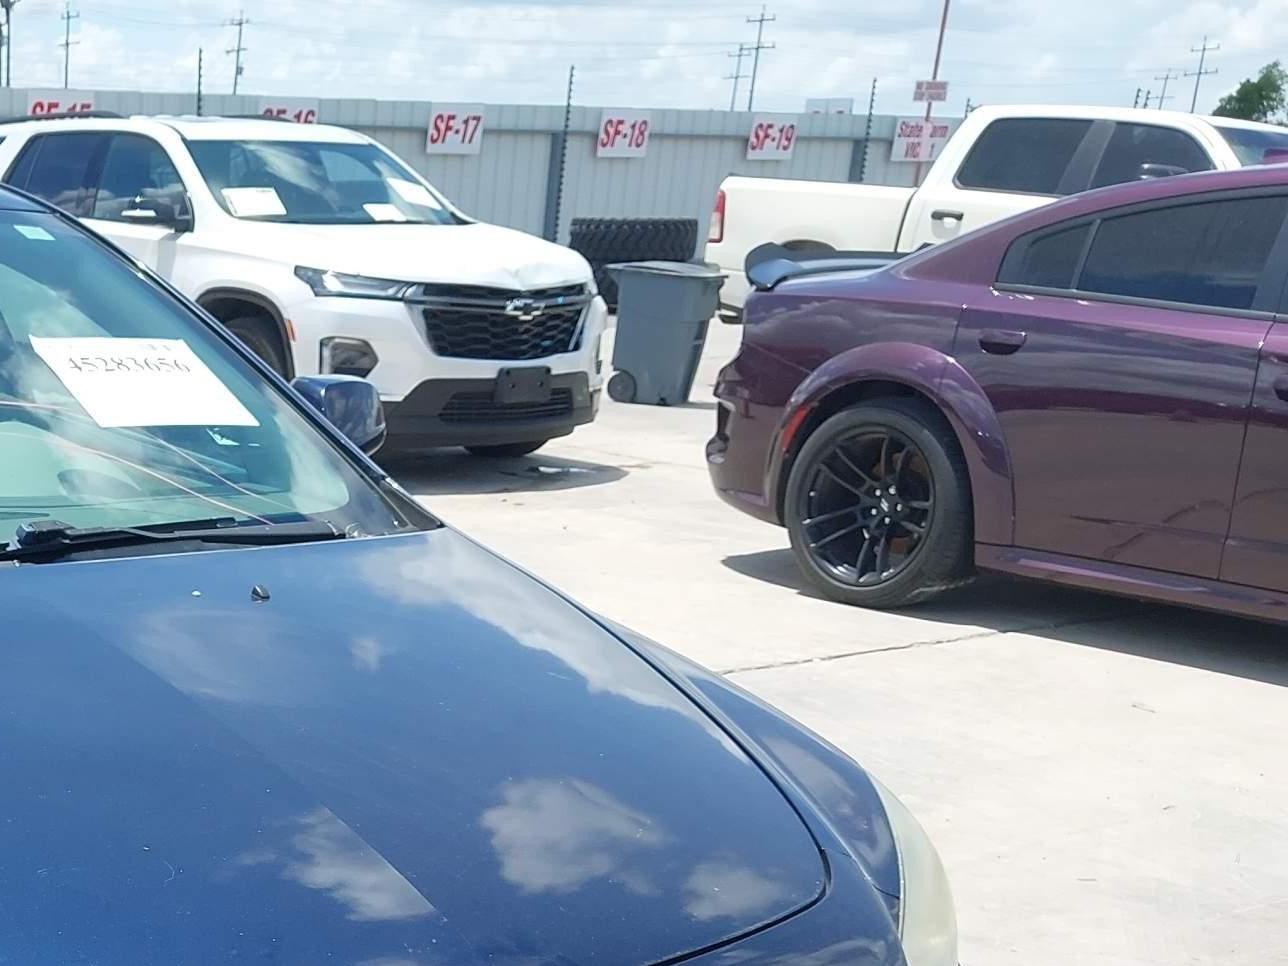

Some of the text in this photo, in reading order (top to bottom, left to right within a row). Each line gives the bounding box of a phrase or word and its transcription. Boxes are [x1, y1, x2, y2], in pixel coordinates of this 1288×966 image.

[430, 113, 482, 144] SF-17
[600, 119, 648, 148] SF-18
[750, 123, 795, 151] SF-19
